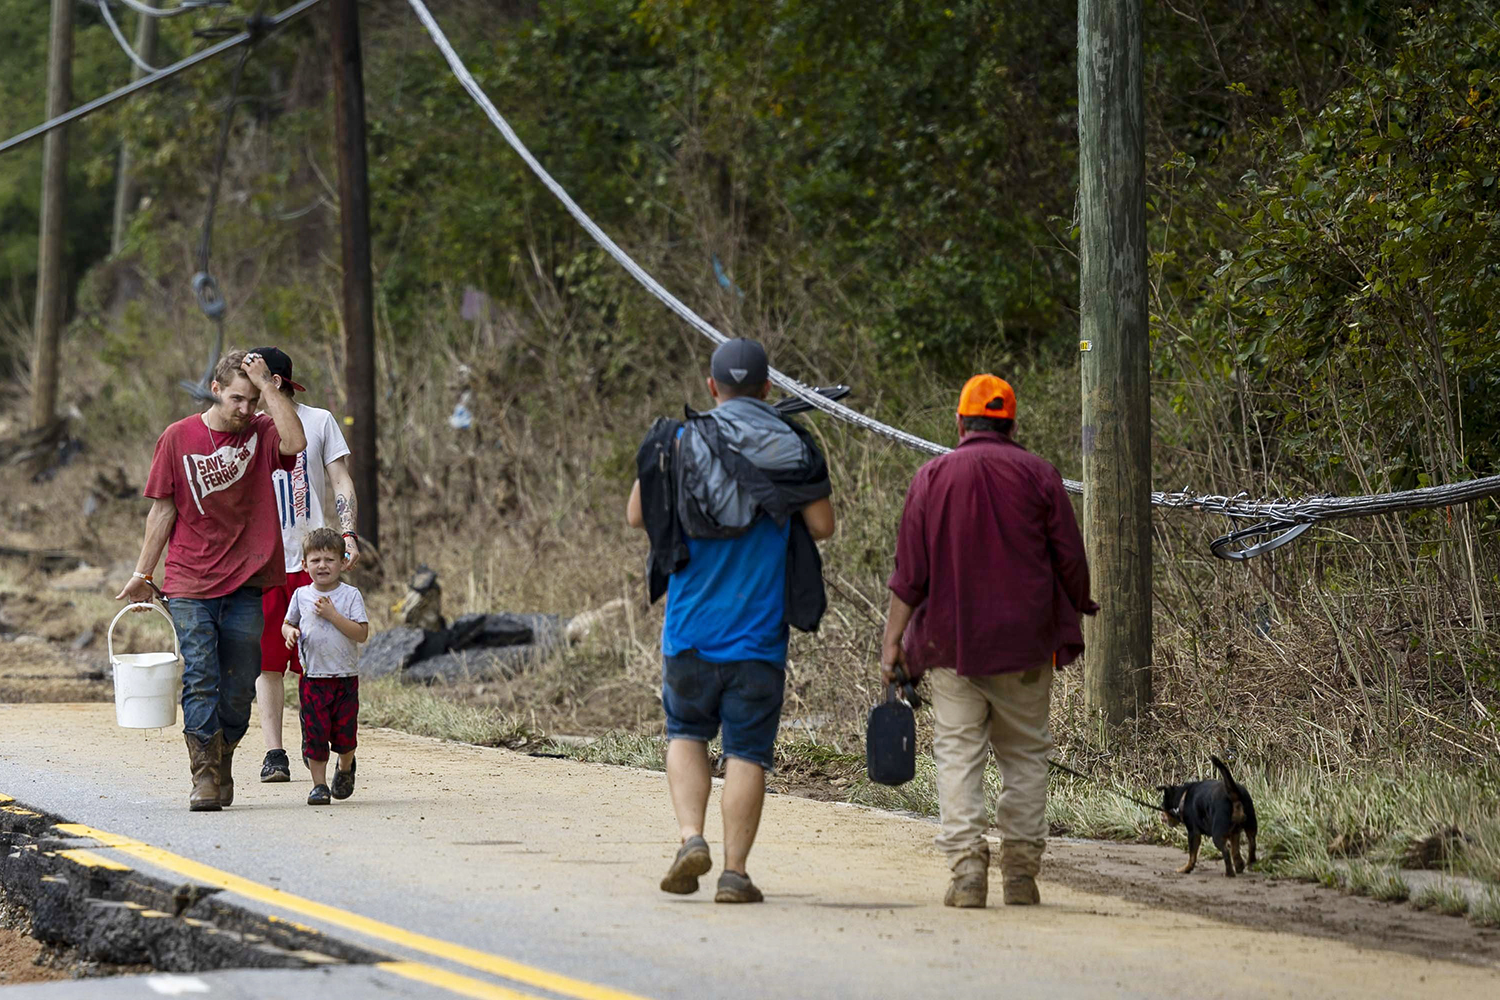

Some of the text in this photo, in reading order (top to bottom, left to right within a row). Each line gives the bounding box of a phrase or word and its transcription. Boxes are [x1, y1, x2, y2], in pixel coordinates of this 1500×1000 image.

[197, 454, 227, 476] SAVE
[202, 461, 239, 491] FERRIS
[289, 481, 309, 518] People
